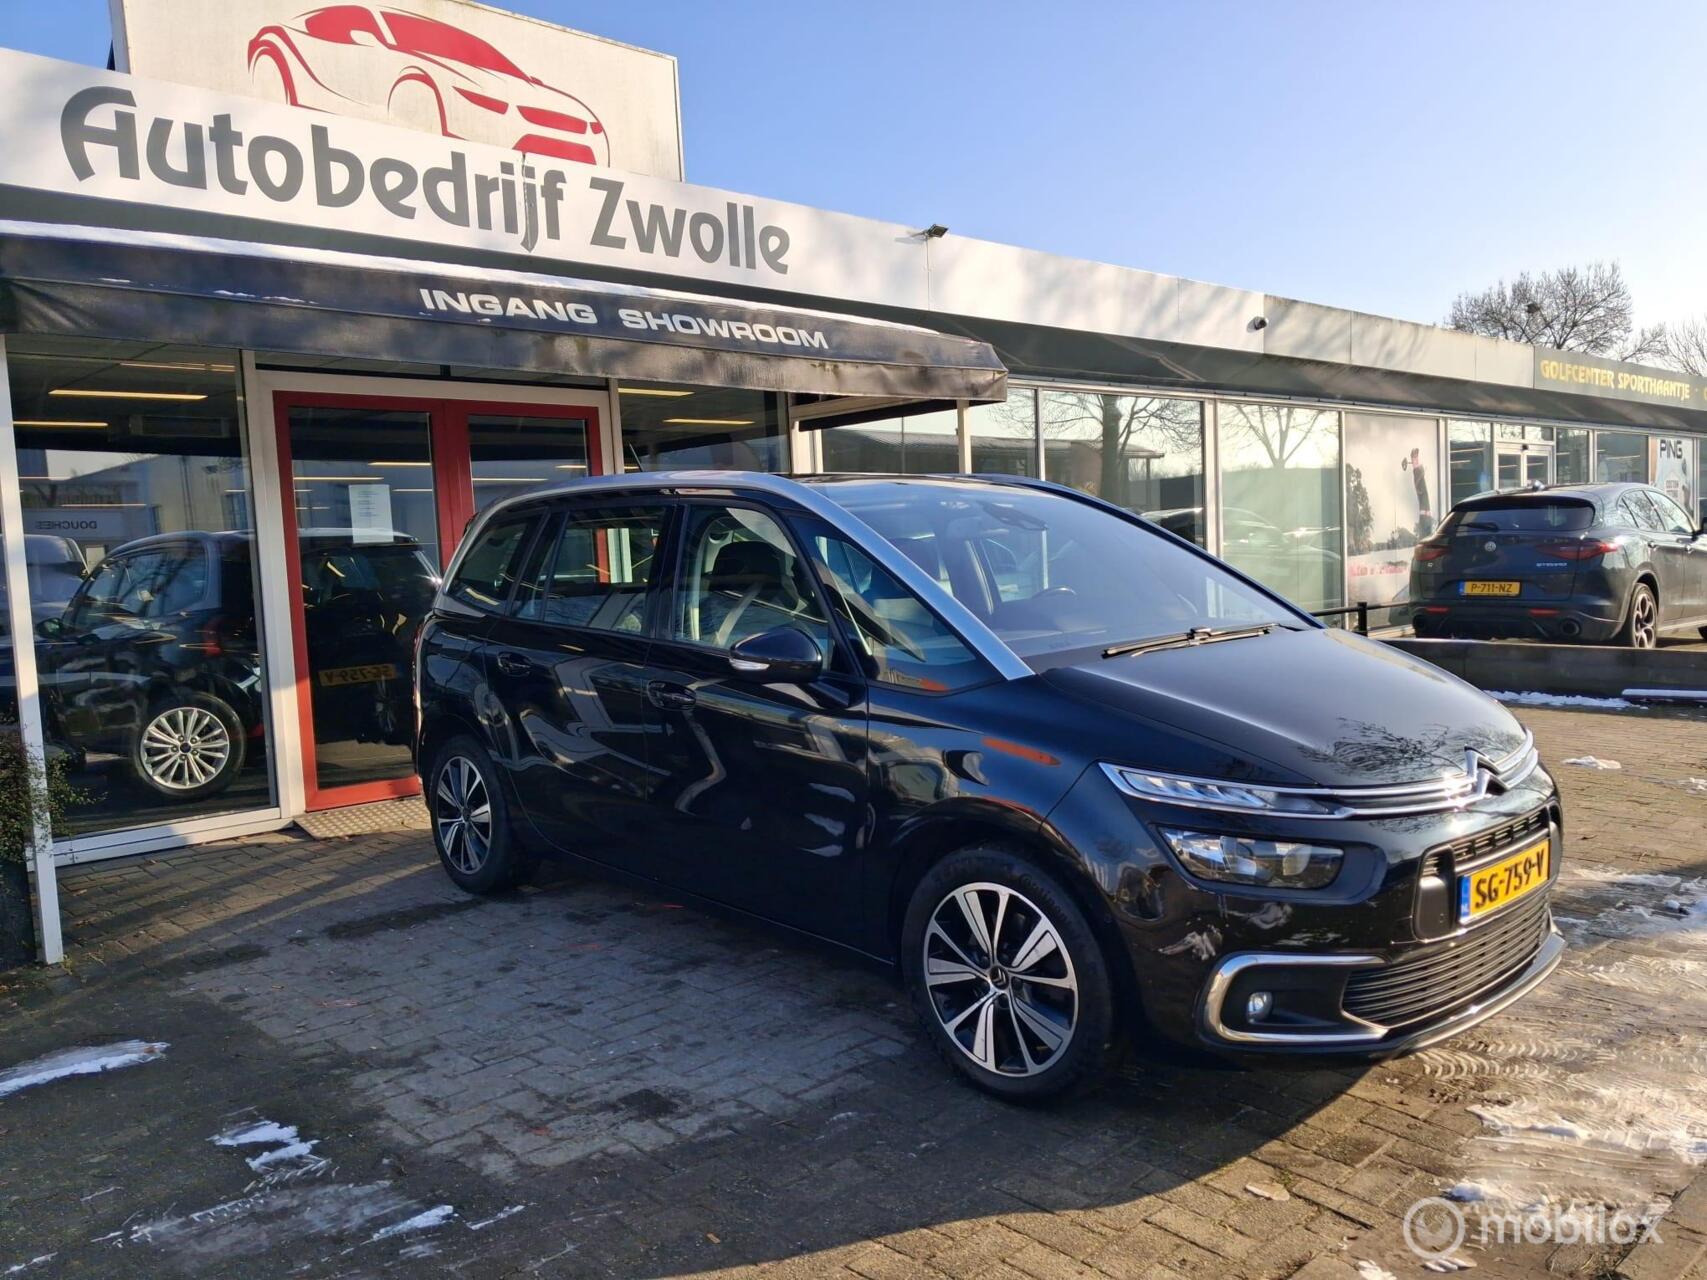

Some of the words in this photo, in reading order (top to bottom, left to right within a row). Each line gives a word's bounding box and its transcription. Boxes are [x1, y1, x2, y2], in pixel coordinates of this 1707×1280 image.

[60, 86, 567, 253] Autobedrijf
[589, 177, 790, 275] Zwolle
[419, 287, 598, 324] INGANG
[618, 308, 829, 350] SHOWROOM
[1539, 359, 1615, 389] GOLFCENTER
[1617, 372, 1690, 400] SPORTHAANTJE
[1660, 439, 1682, 459] PING
[1470, 583, 1513, 593] P-711-NZ
[1475, 848, 1544, 908] SG-759-V
